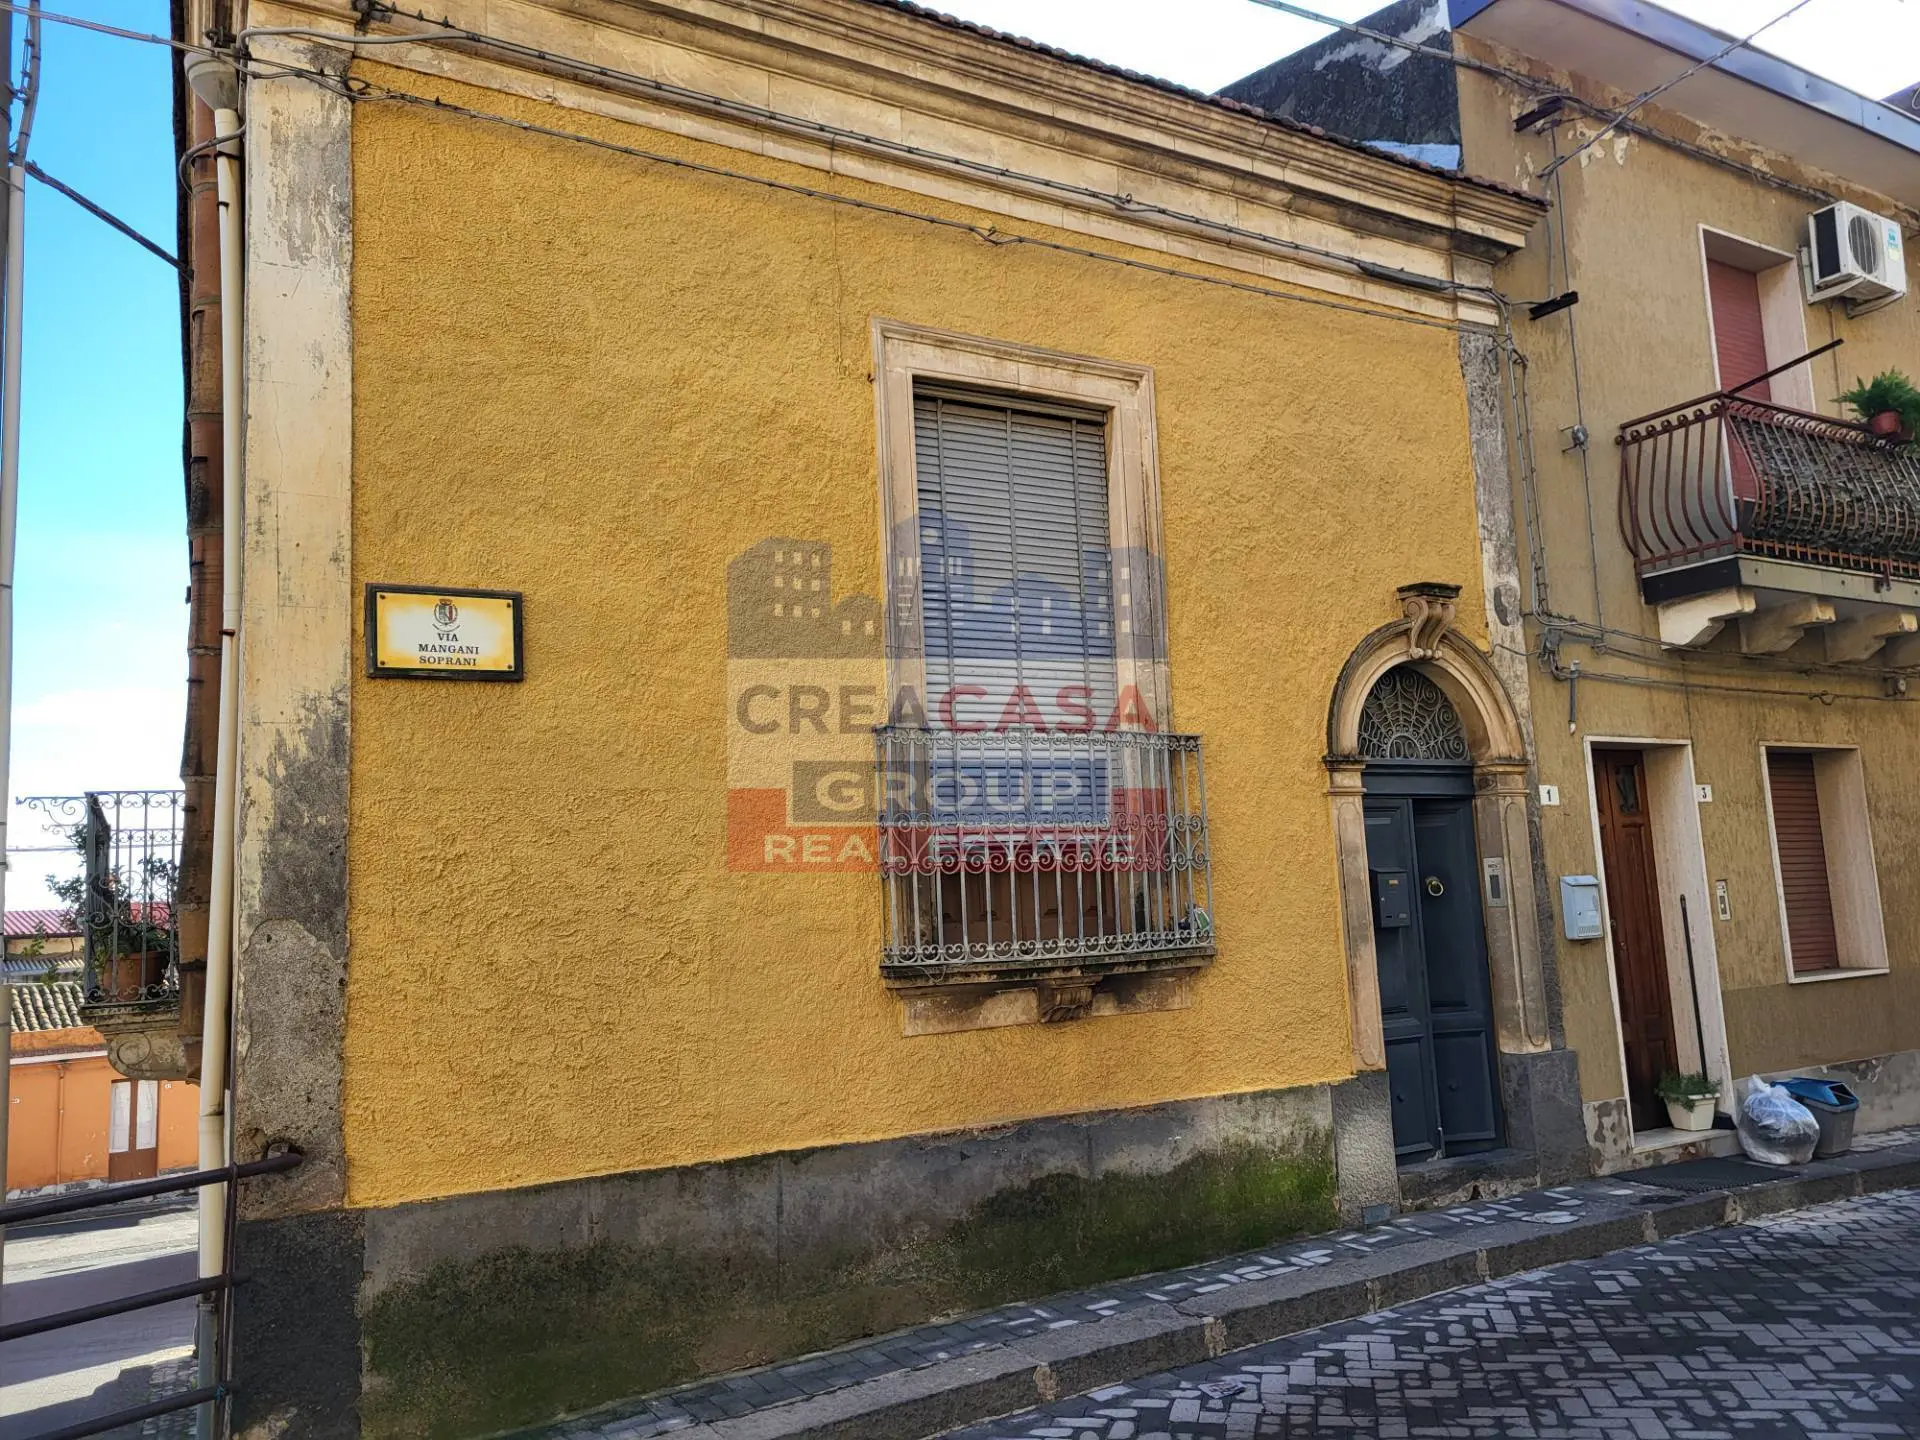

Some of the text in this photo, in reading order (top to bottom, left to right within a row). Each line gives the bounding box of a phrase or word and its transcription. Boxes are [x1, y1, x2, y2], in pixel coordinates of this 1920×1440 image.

[437, 633, 459, 641] VIA
[418, 644, 479, 654] MANGANI
[419, 656, 476, 665] SOPRANI
